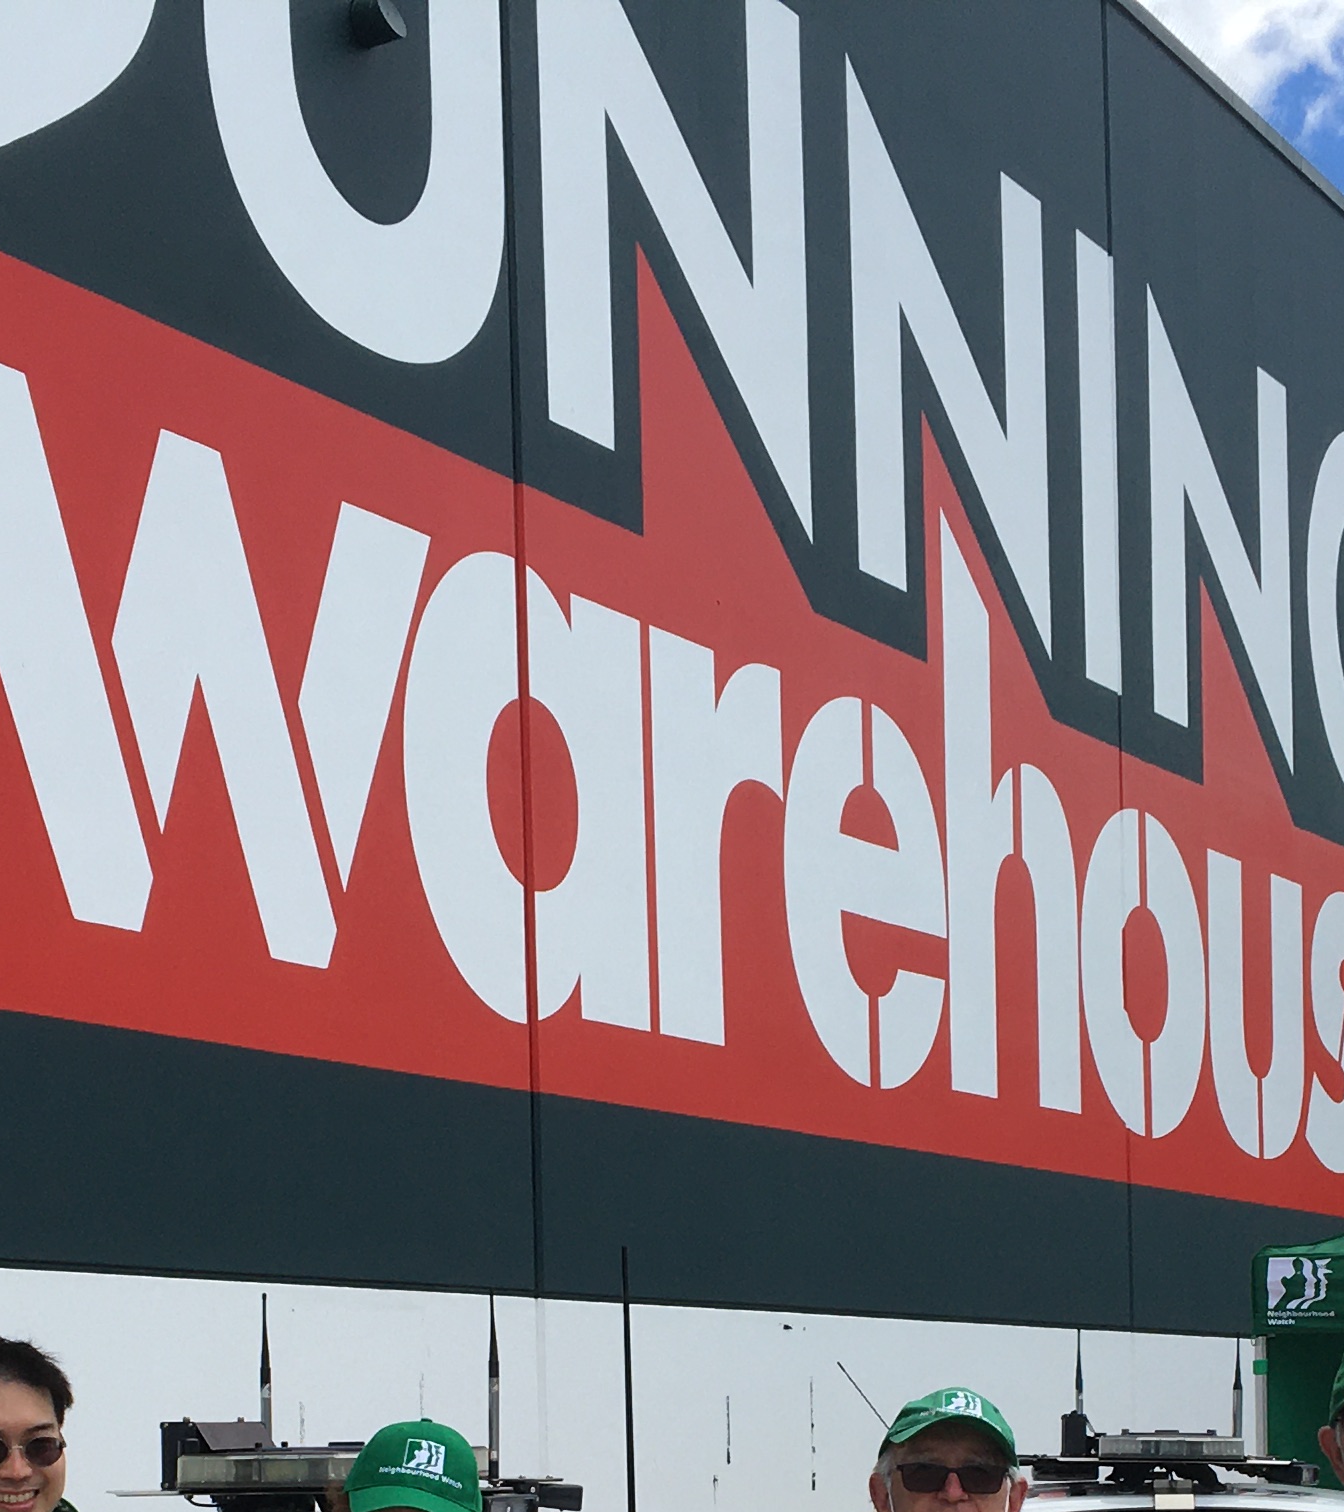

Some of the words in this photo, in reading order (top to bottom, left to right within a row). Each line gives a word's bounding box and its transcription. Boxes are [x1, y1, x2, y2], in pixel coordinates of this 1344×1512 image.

[1267, 1310, 1335, 1318] Neighbourhood
[378, 1466, 440, 1482] Neighbourhood
[441, 1475, 463, 1490] Watch
